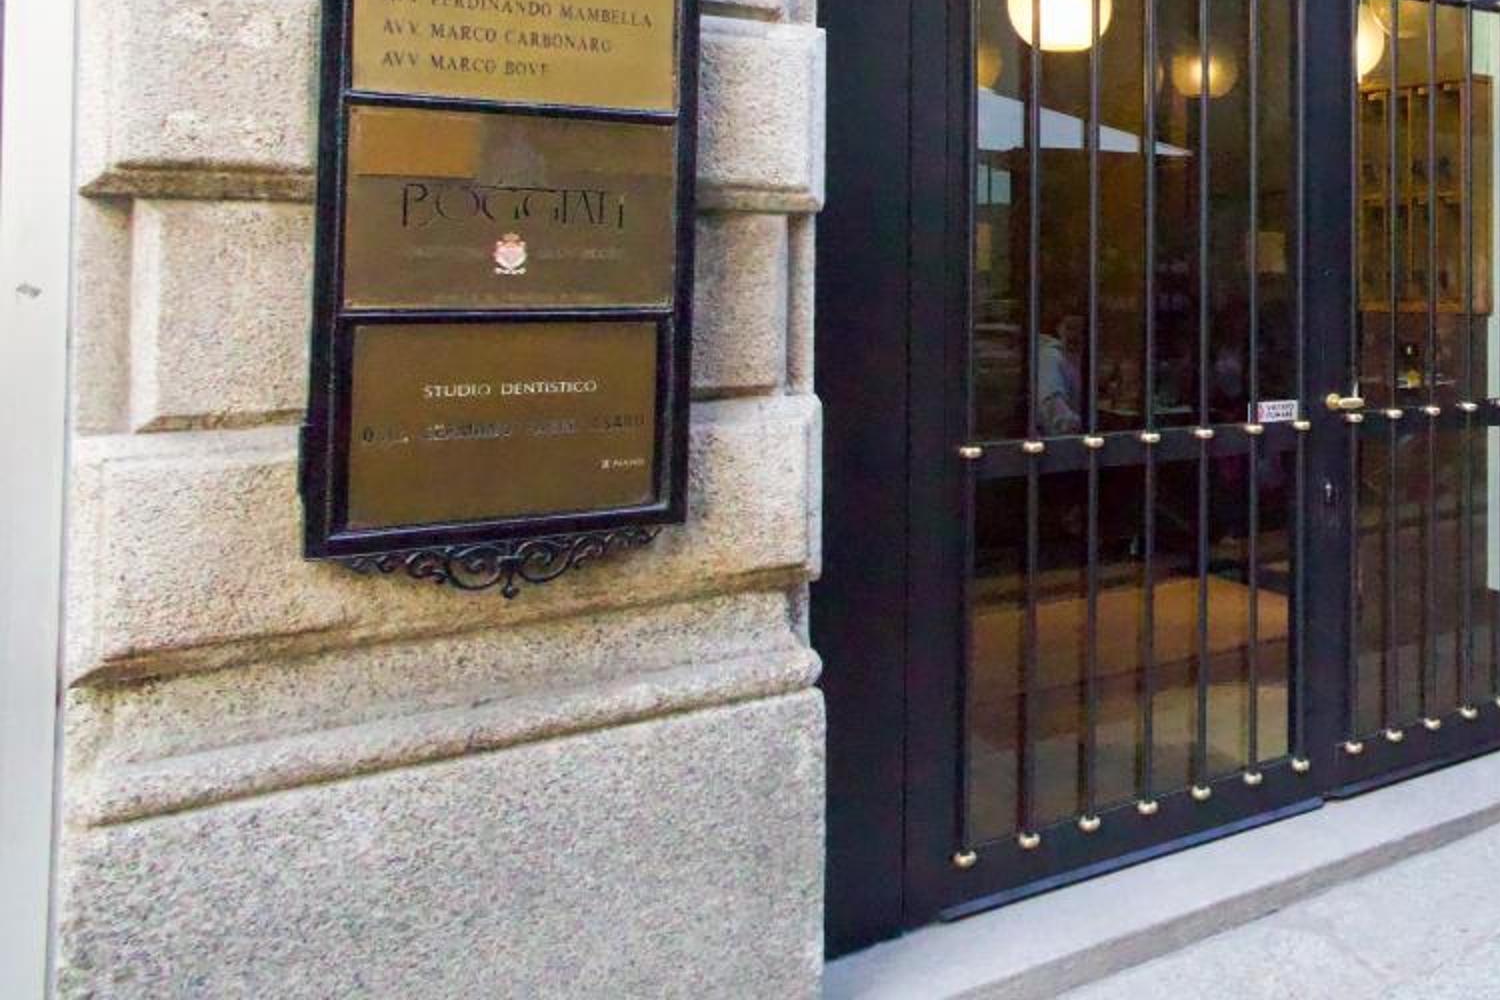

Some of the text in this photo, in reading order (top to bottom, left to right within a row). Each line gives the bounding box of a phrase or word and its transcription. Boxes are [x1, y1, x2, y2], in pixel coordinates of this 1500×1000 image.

[430, 22, 498, 45] MARCO
[430, 53, 498, 75] MARCO
[423, 378, 599, 400] STUDIO DENTISTICO
